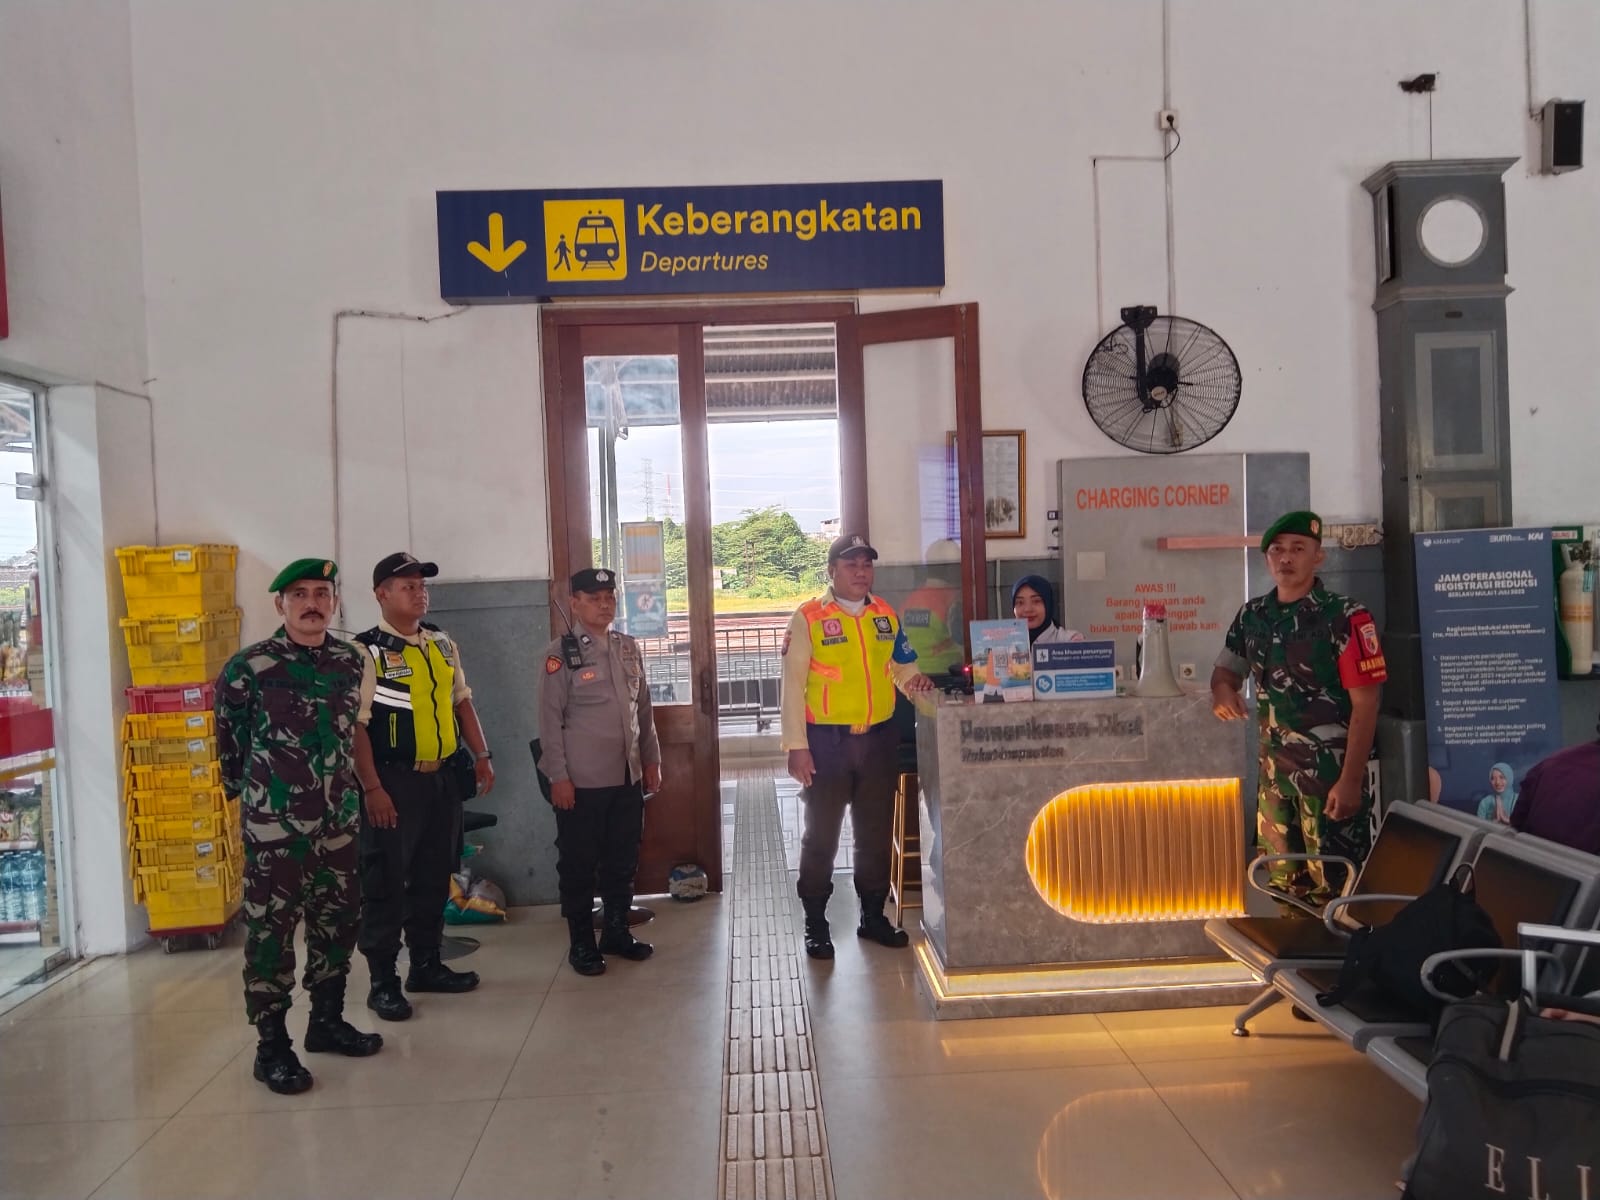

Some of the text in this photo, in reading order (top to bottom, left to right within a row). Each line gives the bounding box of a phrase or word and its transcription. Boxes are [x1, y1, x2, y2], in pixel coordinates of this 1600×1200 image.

[637, 200, 922, 242] Keberangkatan
[640, 250, 769, 277] Departures
[1076, 484, 1230, 510] CHARGING CORNER
[1528, 532, 1543, 542] KAI
[1438, 570, 1534, 583] JAM OPERASIONAL
[1135, 583, 1164, 593] AWAS
[1434, 578, 1538, 592] REGISTRASI REDUKSI
[1106, 597, 1140, 609] Barang
[1182, 595, 1206, 605] anda
[1090, 623, 1119, 633] bukan
[1169, 621, 1197, 633] jawab
